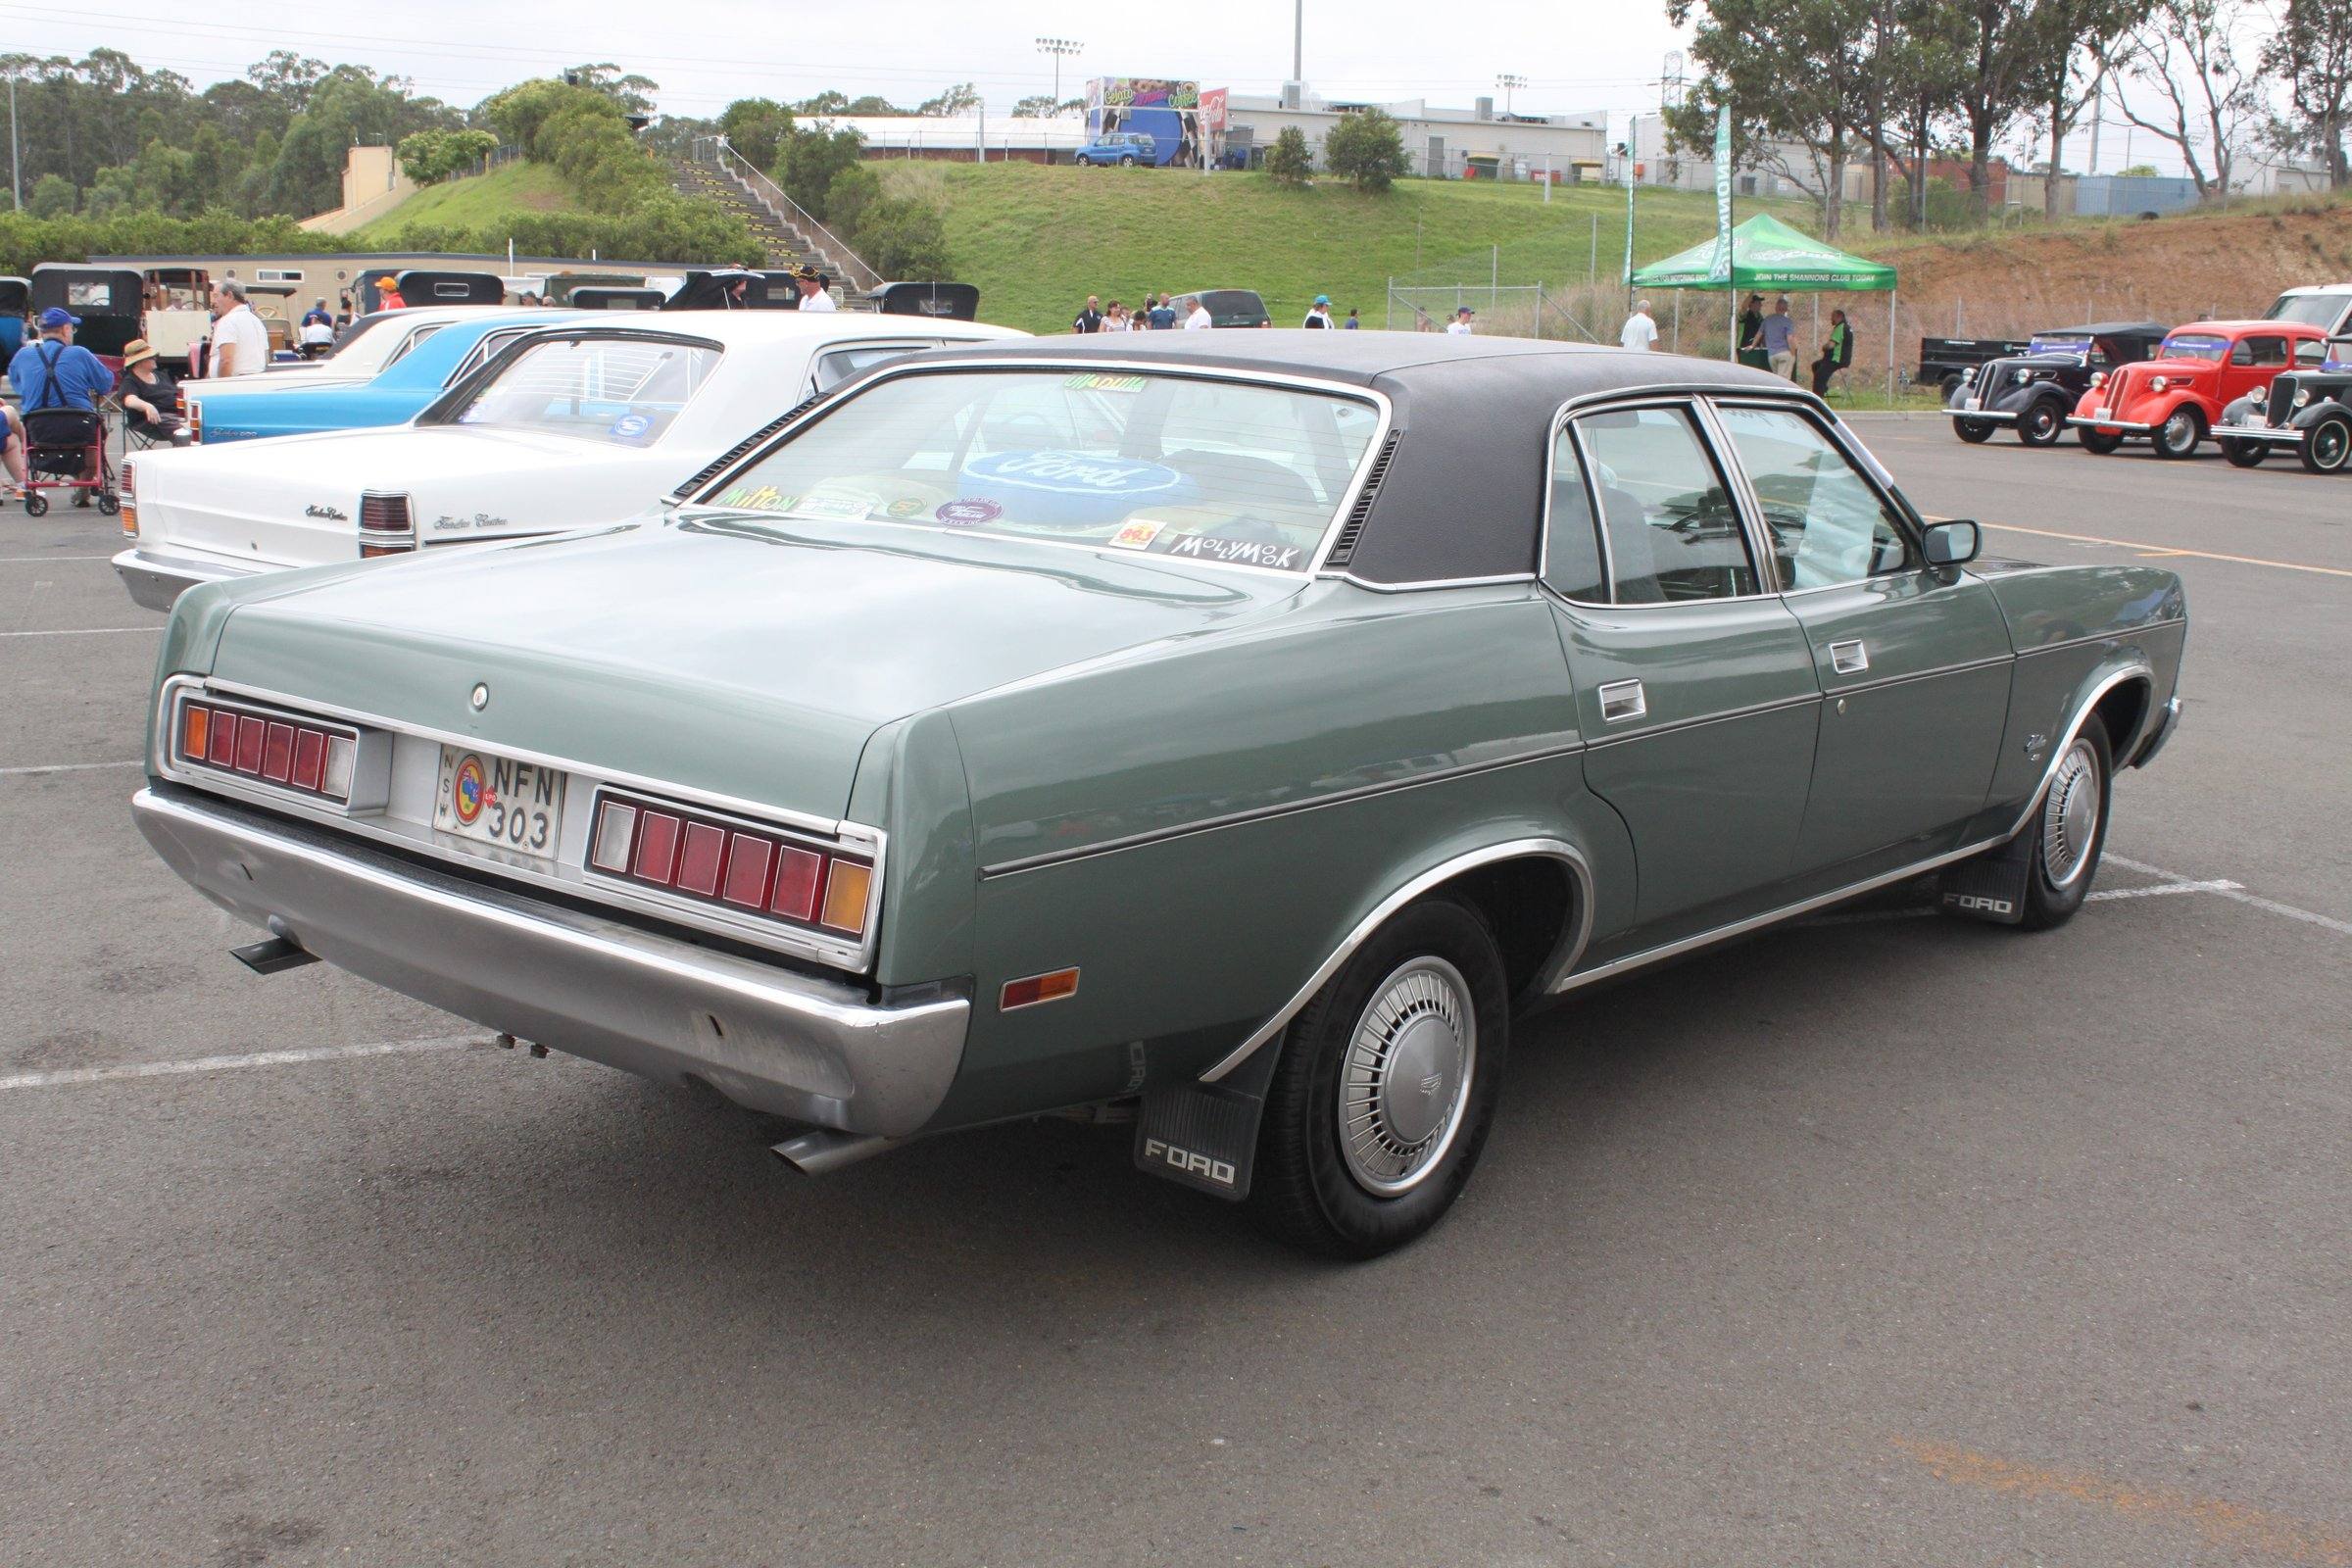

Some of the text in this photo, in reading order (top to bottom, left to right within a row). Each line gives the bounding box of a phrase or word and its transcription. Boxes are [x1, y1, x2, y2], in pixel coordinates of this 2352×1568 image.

[1104, 87, 1134, 105] Gelato
[1788, 273, 1830, 282] SHANNONS
[996, 453, 1150, 487] Ford
[493, 758, 554, 807] NFN
[488, 801, 549, 850] 303
[1943, 893, 2012, 913] FORD
[1145, 1138, 1235, 1184] FORD
